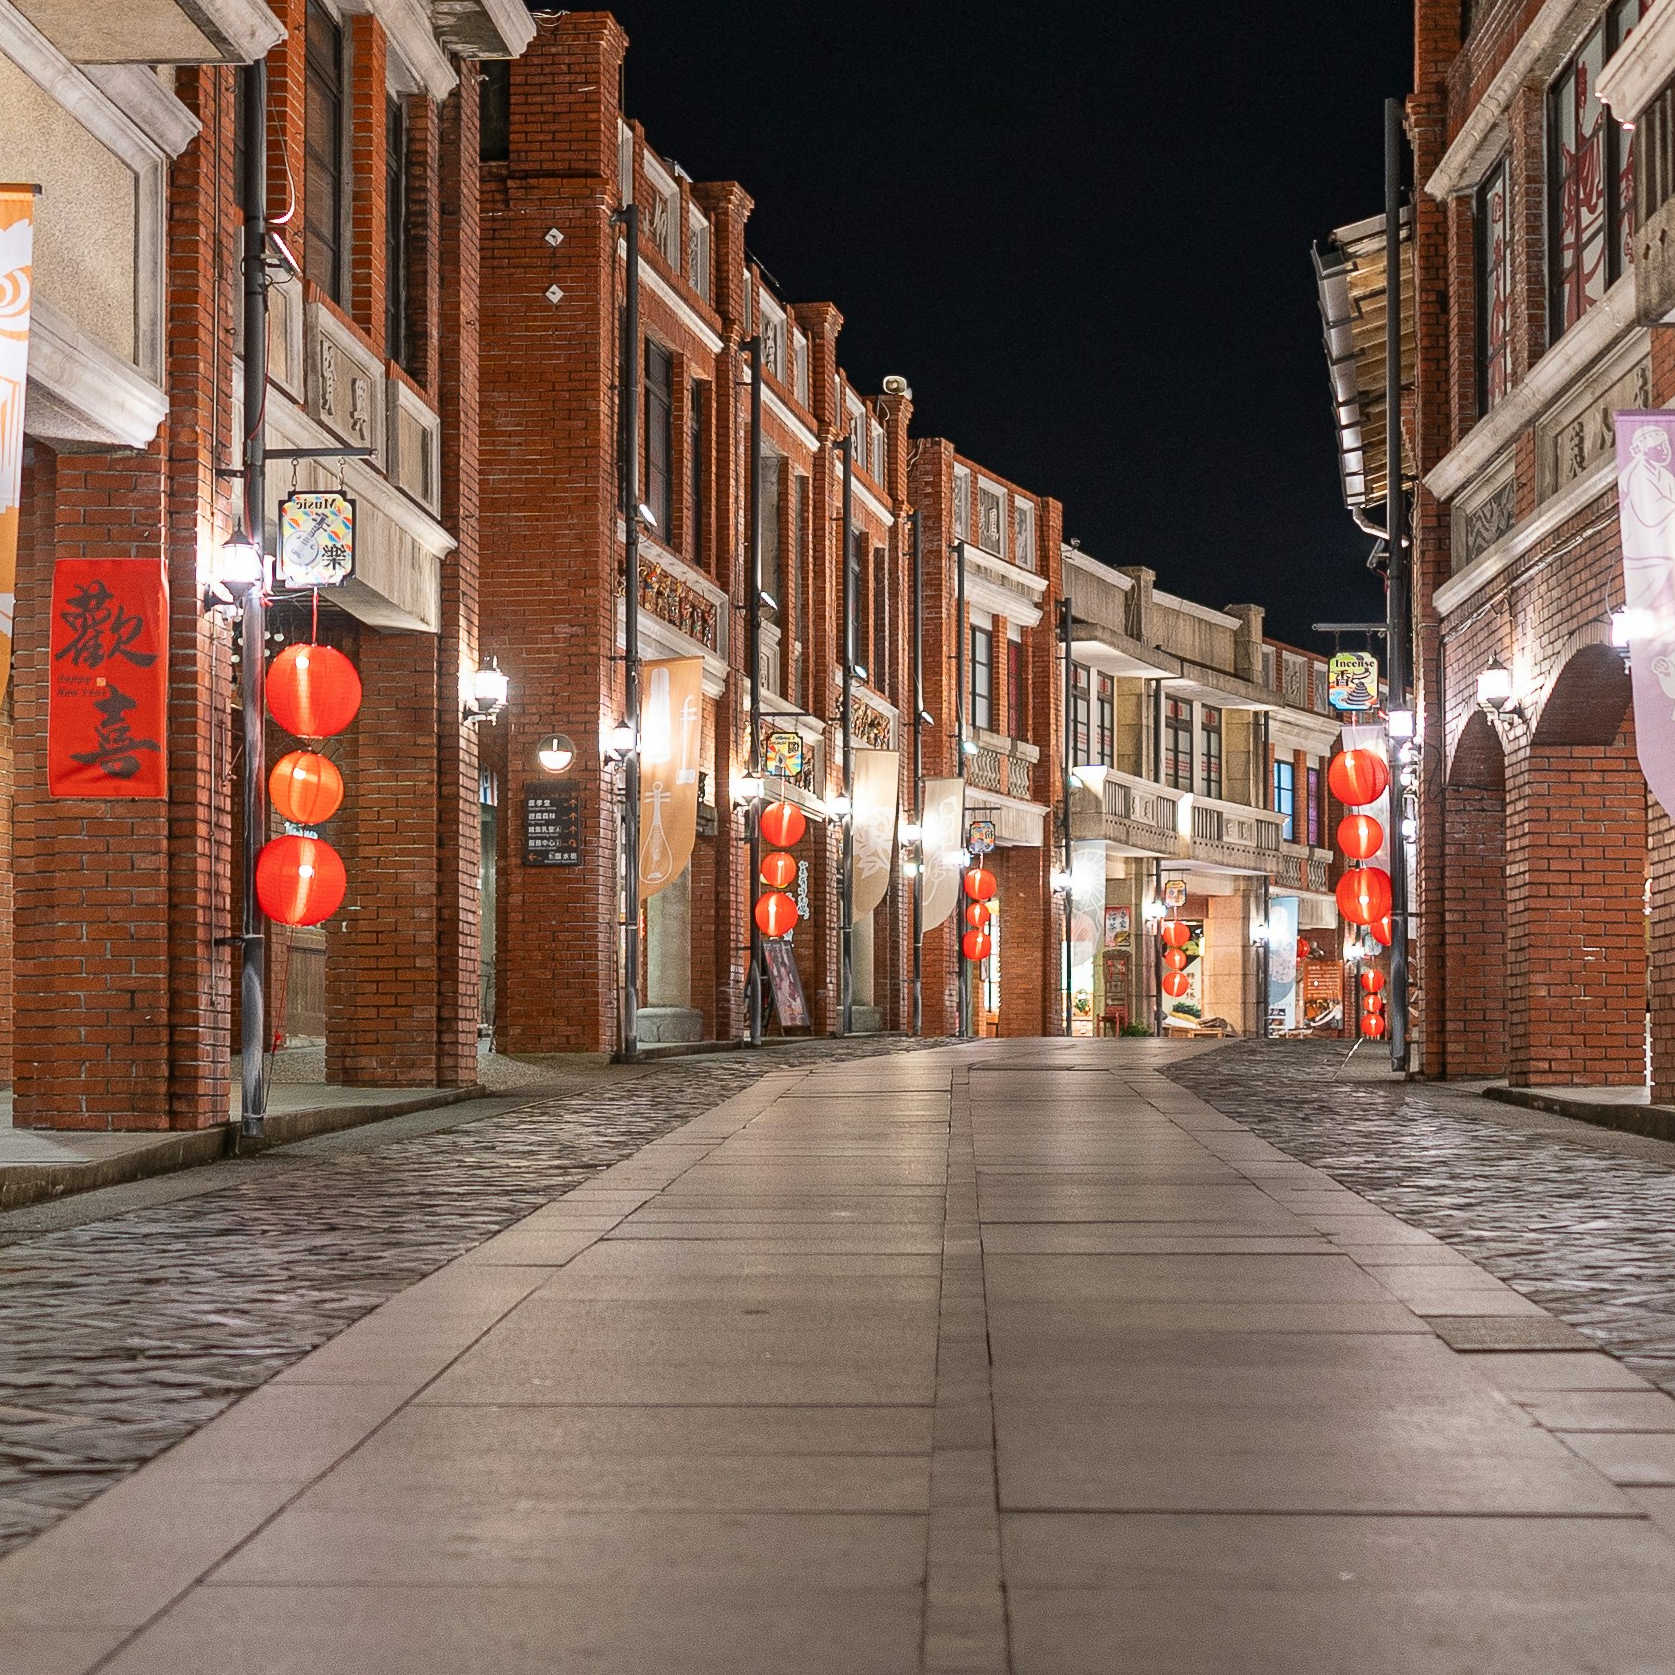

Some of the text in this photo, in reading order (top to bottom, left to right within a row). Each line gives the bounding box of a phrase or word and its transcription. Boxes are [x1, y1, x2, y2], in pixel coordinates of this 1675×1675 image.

[1335, 659, 1375, 668] Incense
[55, 579, 162, 780] 歡喜
[1334, 669, 1352, 687] 香
